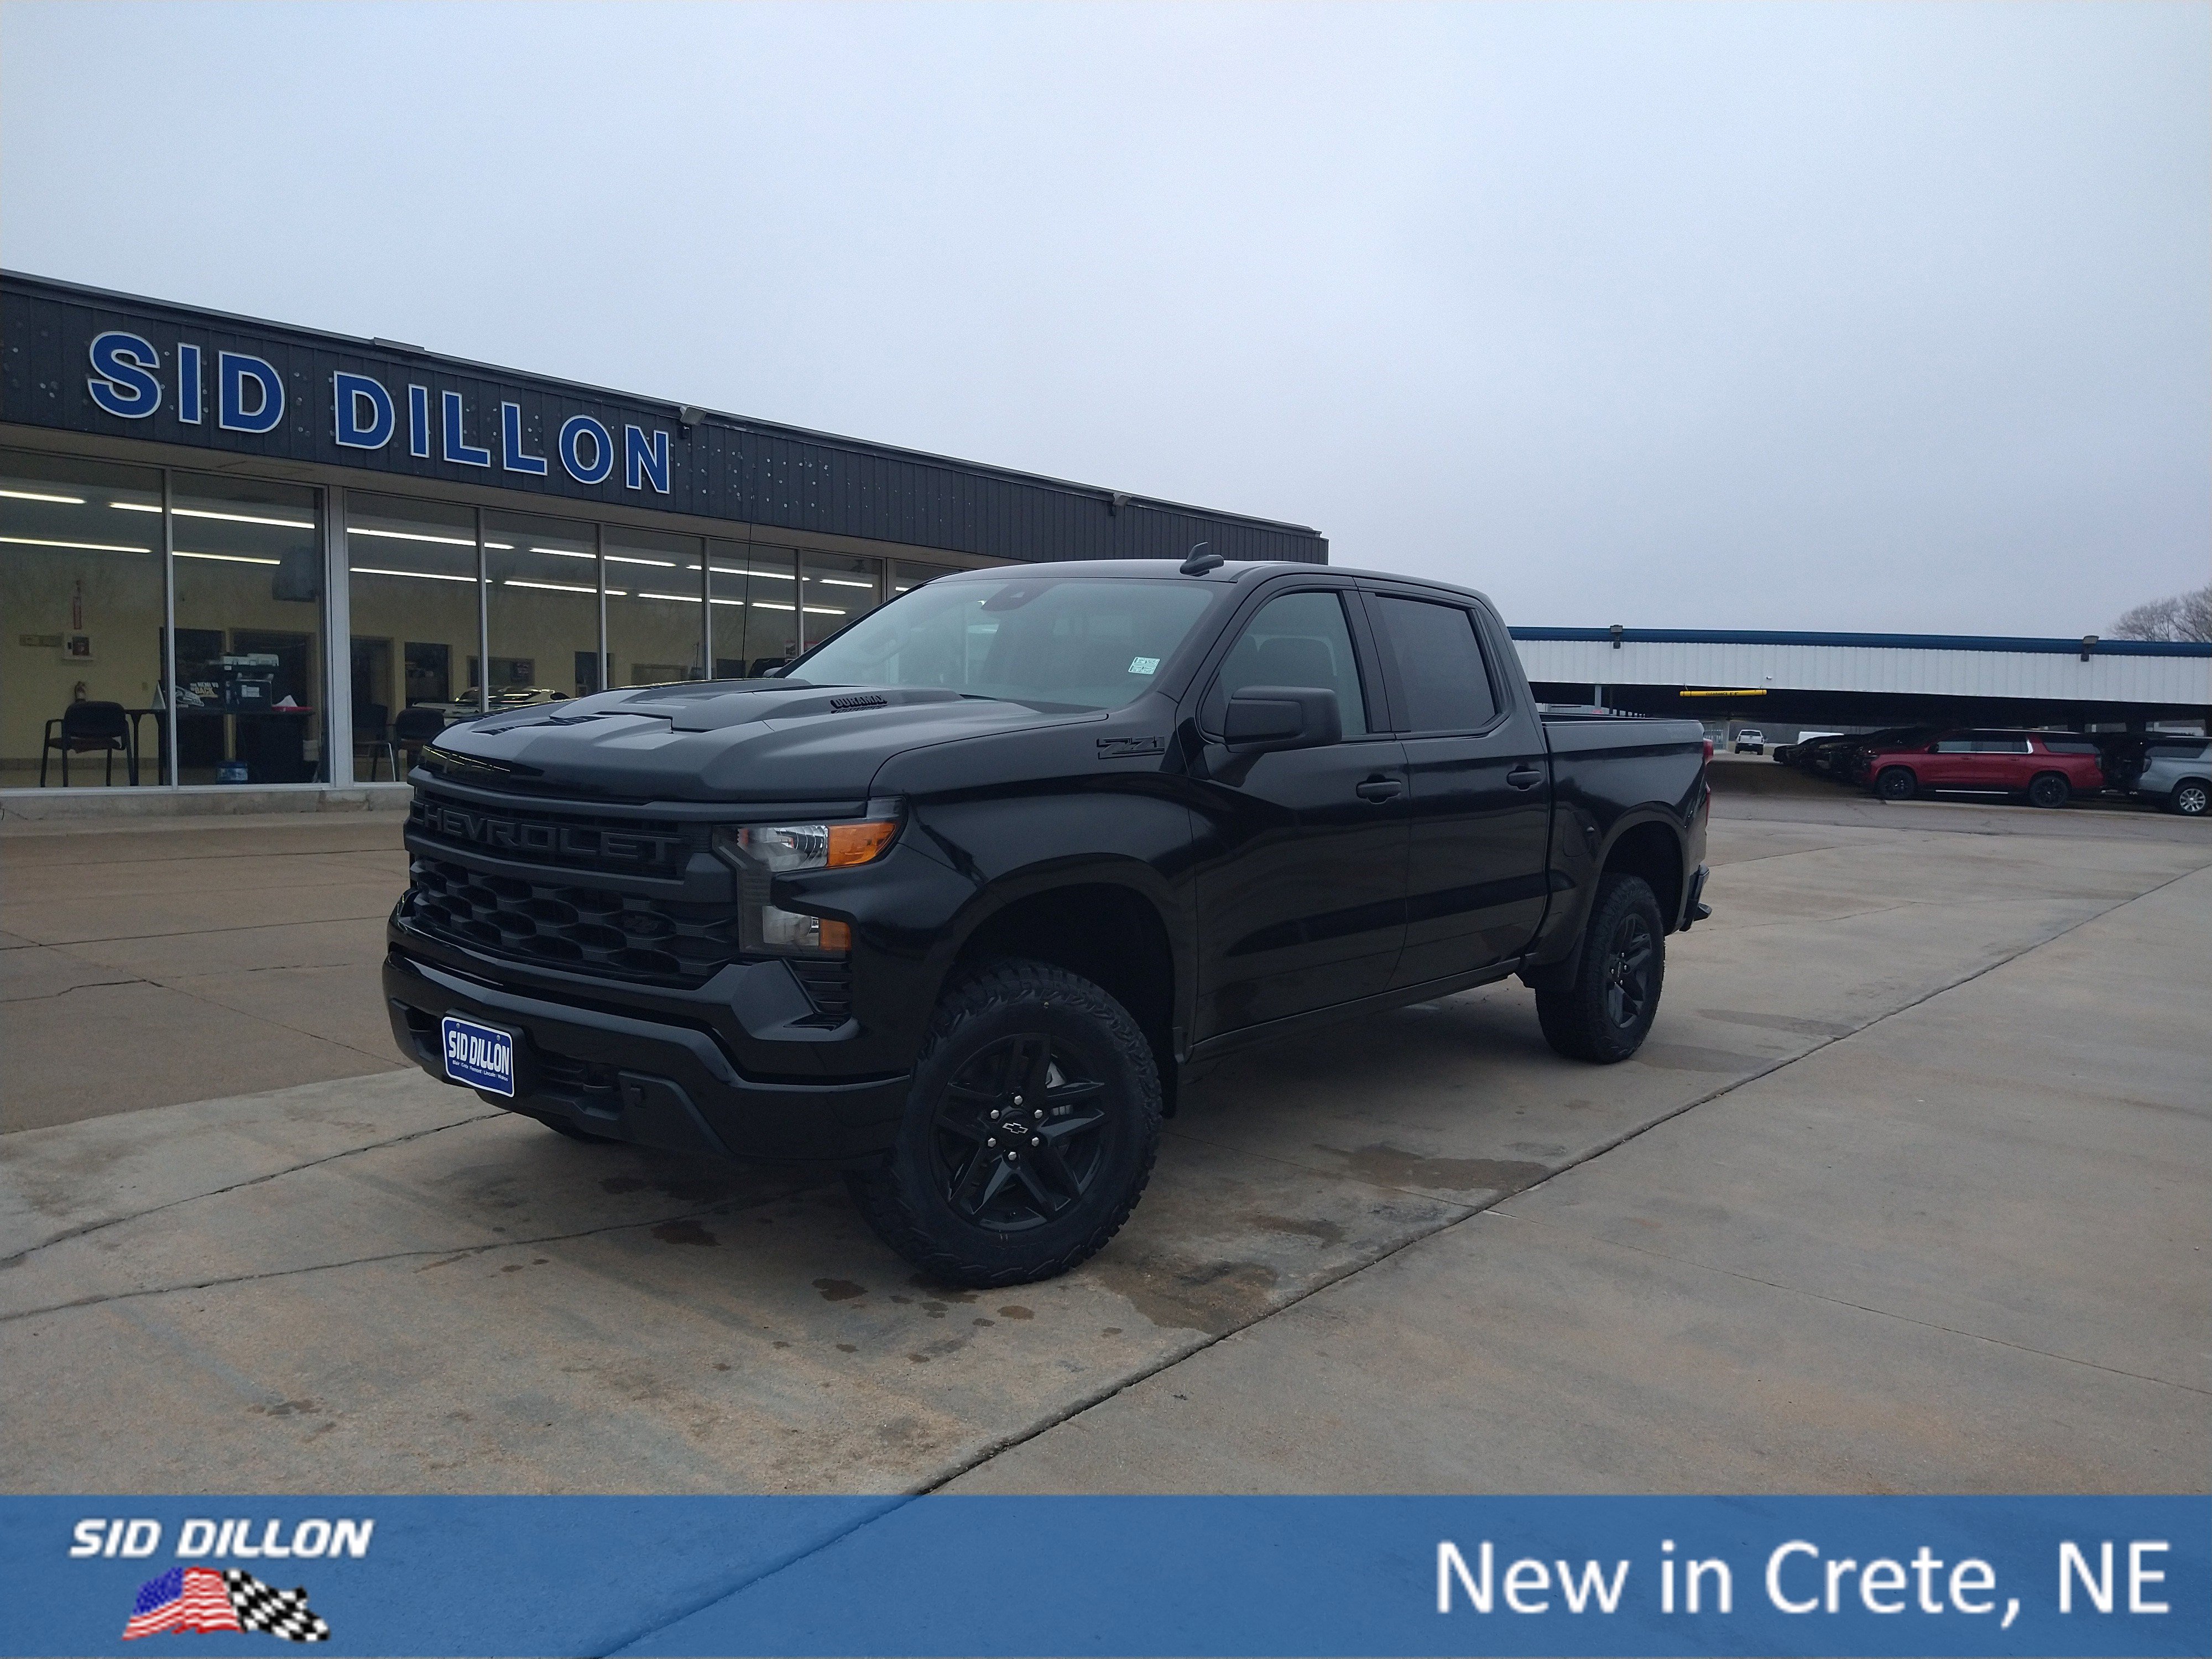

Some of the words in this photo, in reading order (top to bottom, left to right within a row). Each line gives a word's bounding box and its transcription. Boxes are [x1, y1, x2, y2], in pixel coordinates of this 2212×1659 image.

[87, 331, 285, 433] SID
[333, 371, 671, 494] DILLON
[830, 695, 888, 709] DURAMAX
[410, 800, 682, 862] CHEVROLET
[449, 1030, 468, 1061] SID
[469, 1036, 510, 1076] DILLON
